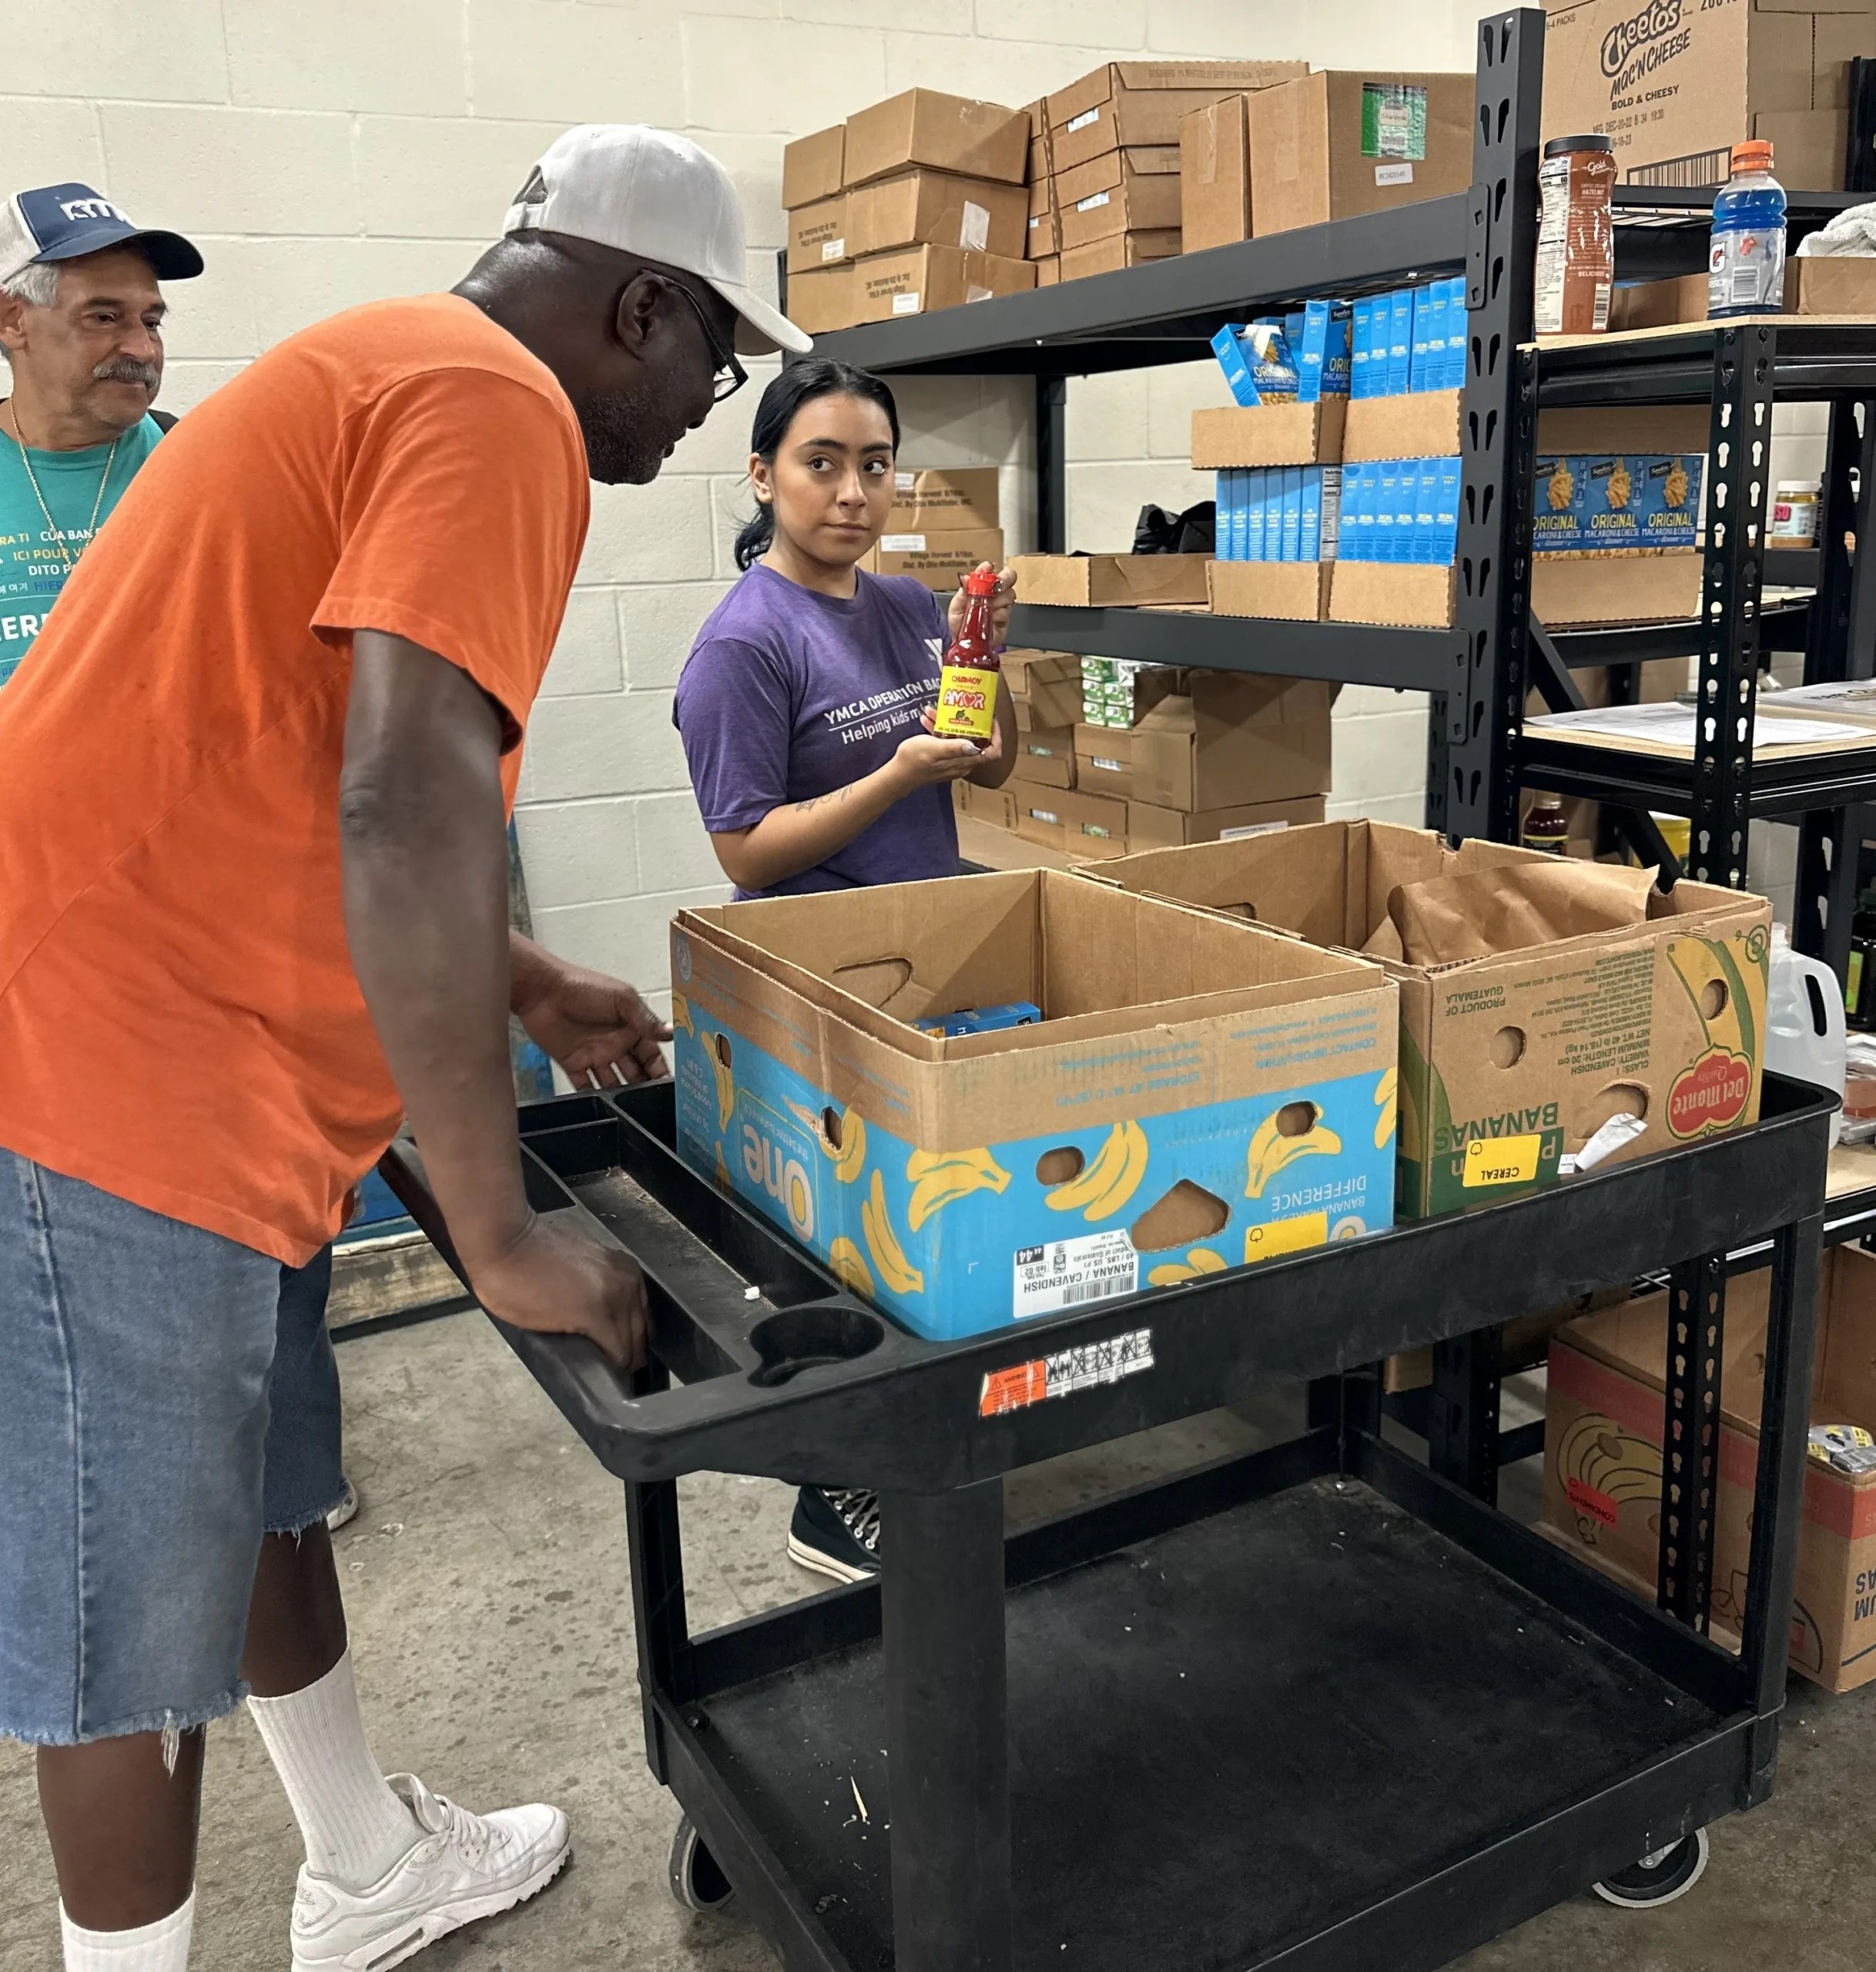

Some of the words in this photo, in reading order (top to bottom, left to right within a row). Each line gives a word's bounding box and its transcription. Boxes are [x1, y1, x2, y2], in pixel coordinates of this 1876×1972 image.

[1556, 13, 1576, 26] PACKS
[1601, 0, 1683, 77] Cheetos
[1647, 28, 1691, 72] CHEESE
[1612, 96, 1633, 110] BOLD
[1636, 95, 1643, 104] &
[1645, 85, 1680, 102] CHEESY
[1533, 515, 1579, 531] ORIGINAL
[1590, 514, 1636, 529] ORIGINAL
[1648, 512, 1693, 528] ORIGINAL
[13, 550, 30, 562] ICI
[28, 564, 59, 576] DITO
[952, 675, 982, 685] CHAMOY
[824, 700, 869, 725] YMCA
[841, 718, 892, 744] Helping
[890, 710, 910, 727] kids
[1446, 986, 1504, 1004] GUATEMALA
[1446, 1005, 1459, 1017] OF
[1460, 997, 1506, 1015] PRODUCT
[1611, 1035, 1620, 1045] 40
[1623, 1031, 1634, 1043] WT.
[1636, 1028, 1650, 1038] NET
[1329, 1038, 1376, 1056] CONTACT
[1565, 1043, 1578, 1055] kg)
[1603, 1038, 1610, 1048] lb
[1618, 1038, 1650, 1054] MINIMUM
[1558, 1058, 1570, 1066] cm
[1572, 1055, 1581, 1065] 20
[1583, 1047, 1616, 1062] LENGTH:
[1617, 1049, 1649, 1063] VARIETY:
[1571, 1058, 1616, 1075] CAVENDISH
[1623, 1060, 1648, 1073] CLASS:
[1723, 1075, 1744, 1103] Del
[1673, 1084, 1720, 1116] Monte
[1433, 1102, 1559, 1152] BANANAS
[796, 1143, 808, 1162] the
[1481, 1167, 1519, 1181] CEREAL
[743, 1124, 814, 1243] One
[1271, 1175, 1366, 1212] DIFFERENCE
[1322, 1196, 1365, 1215] BANANA
[1020, 1250, 1033, 1263] 44
[1094, 1259, 1103, 1267] US
[1093, 1261, 1134, 1278] BANANA
[1023, 1272, 1082, 1293] CAVENDISH
